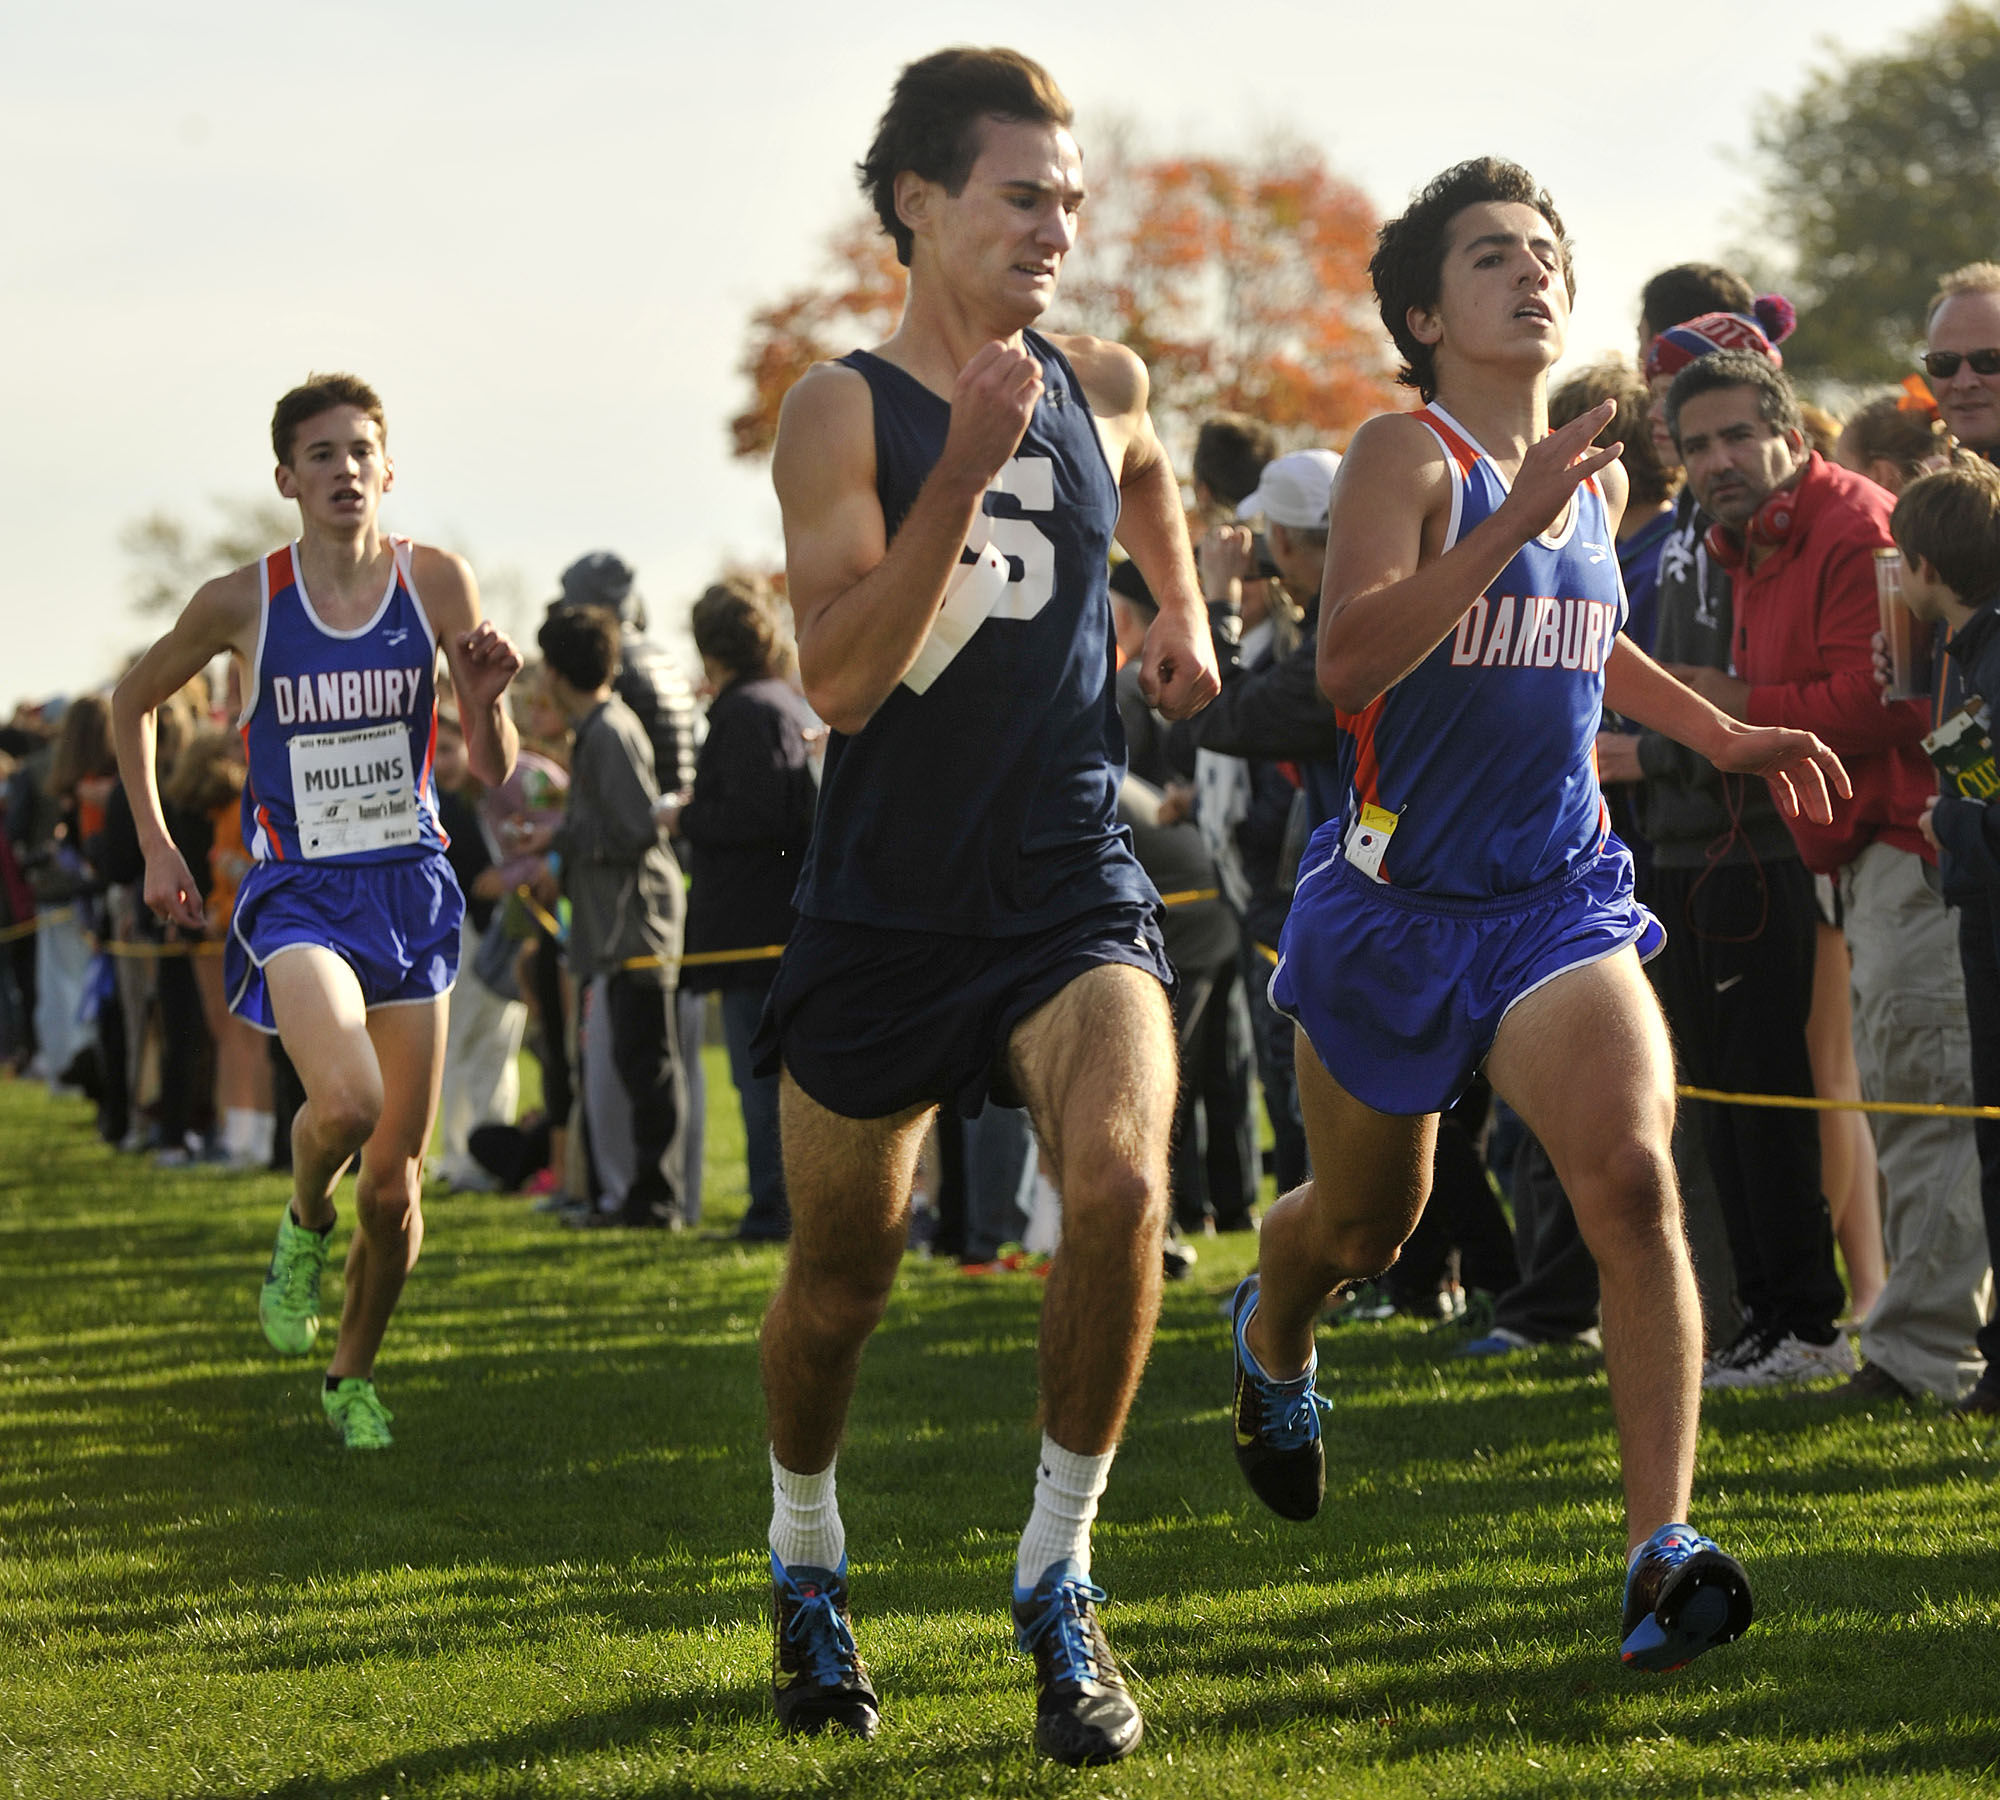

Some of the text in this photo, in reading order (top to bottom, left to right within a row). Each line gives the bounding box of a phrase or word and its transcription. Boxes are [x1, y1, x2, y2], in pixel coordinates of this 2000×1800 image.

[952, 456, 1056, 621] S
[1451, 595, 1617, 672] DANBURY
[273, 667, 421, 725] DANBURY
[304, 757, 404, 792] MULLINS
